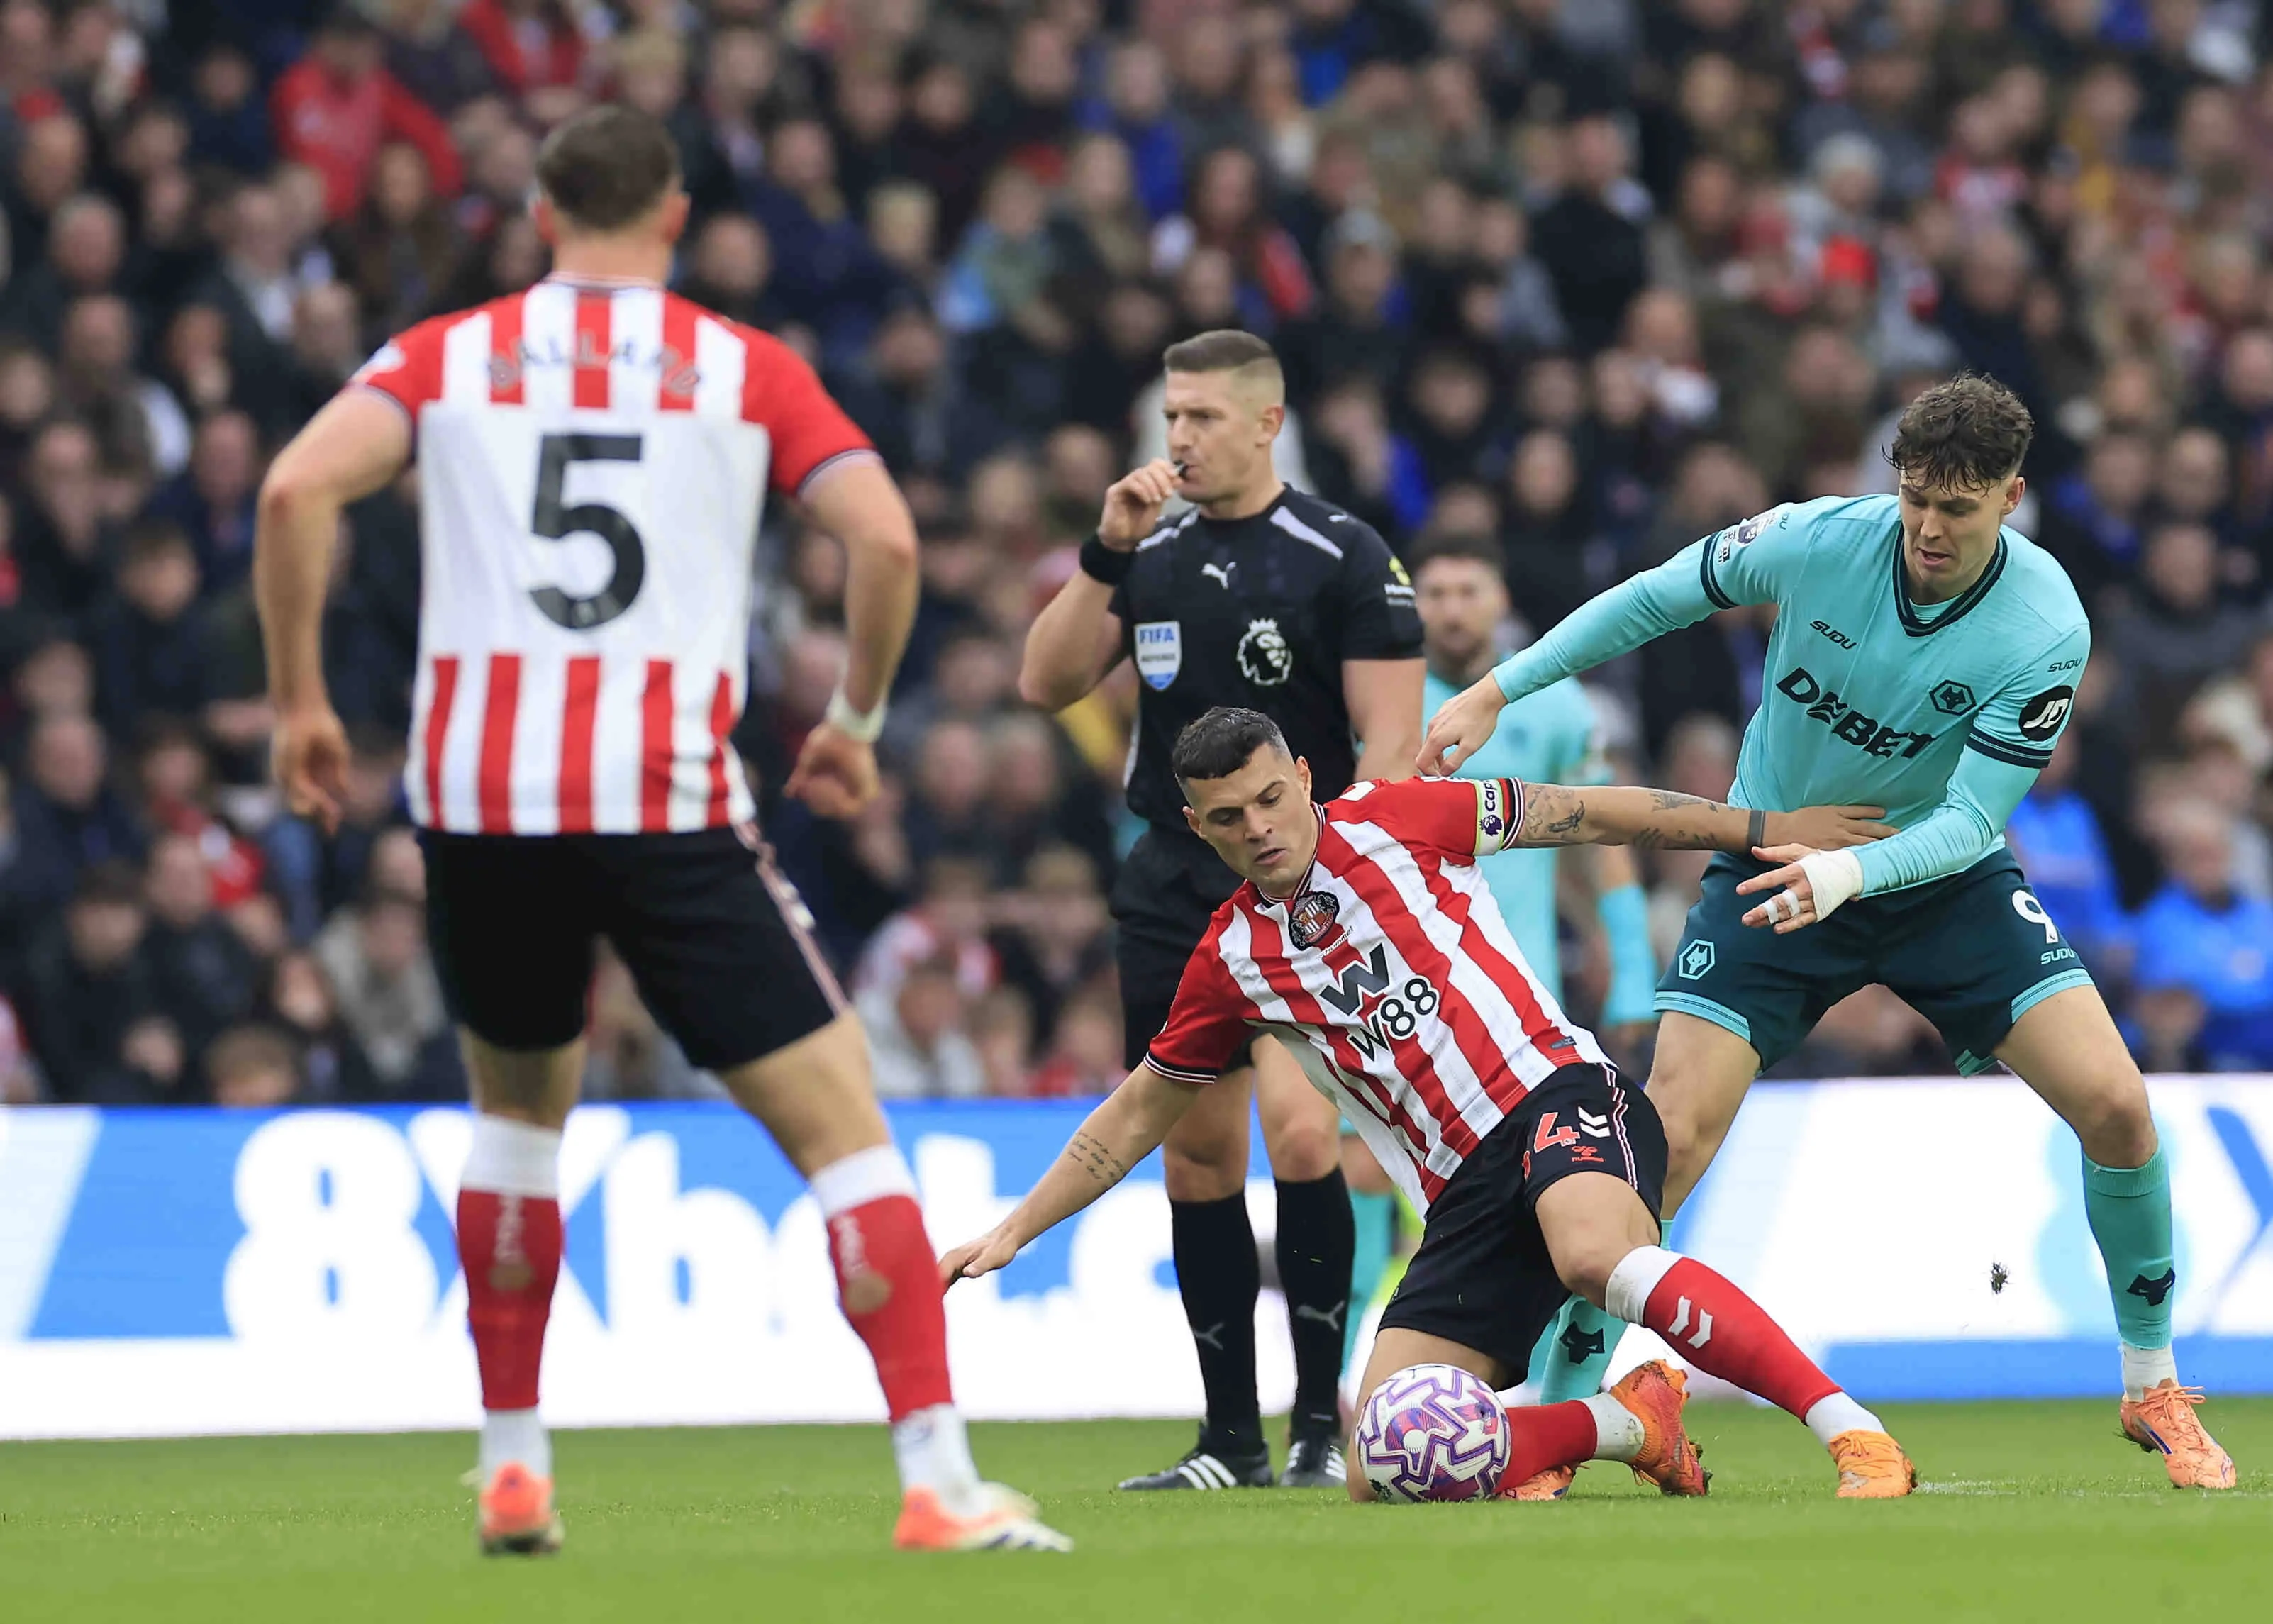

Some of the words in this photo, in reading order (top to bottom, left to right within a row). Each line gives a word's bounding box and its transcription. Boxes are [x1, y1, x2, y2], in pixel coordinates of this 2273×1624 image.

[529, 433, 645, 631] 5
[1138, 627, 1175, 645] FIFA
[1809, 620, 1857, 650] SUDU
[2047, 657, 2083, 673] SUDU
[1775, 667, 1938, 759] DEBET
[2023, 698, 2070, 729] JD
[1484, 779, 1498, 812] Cap
[2011, 889, 2059, 944] 9
[2040, 947, 2076, 965] SUDU
[1348, 977, 1438, 1062] W88
